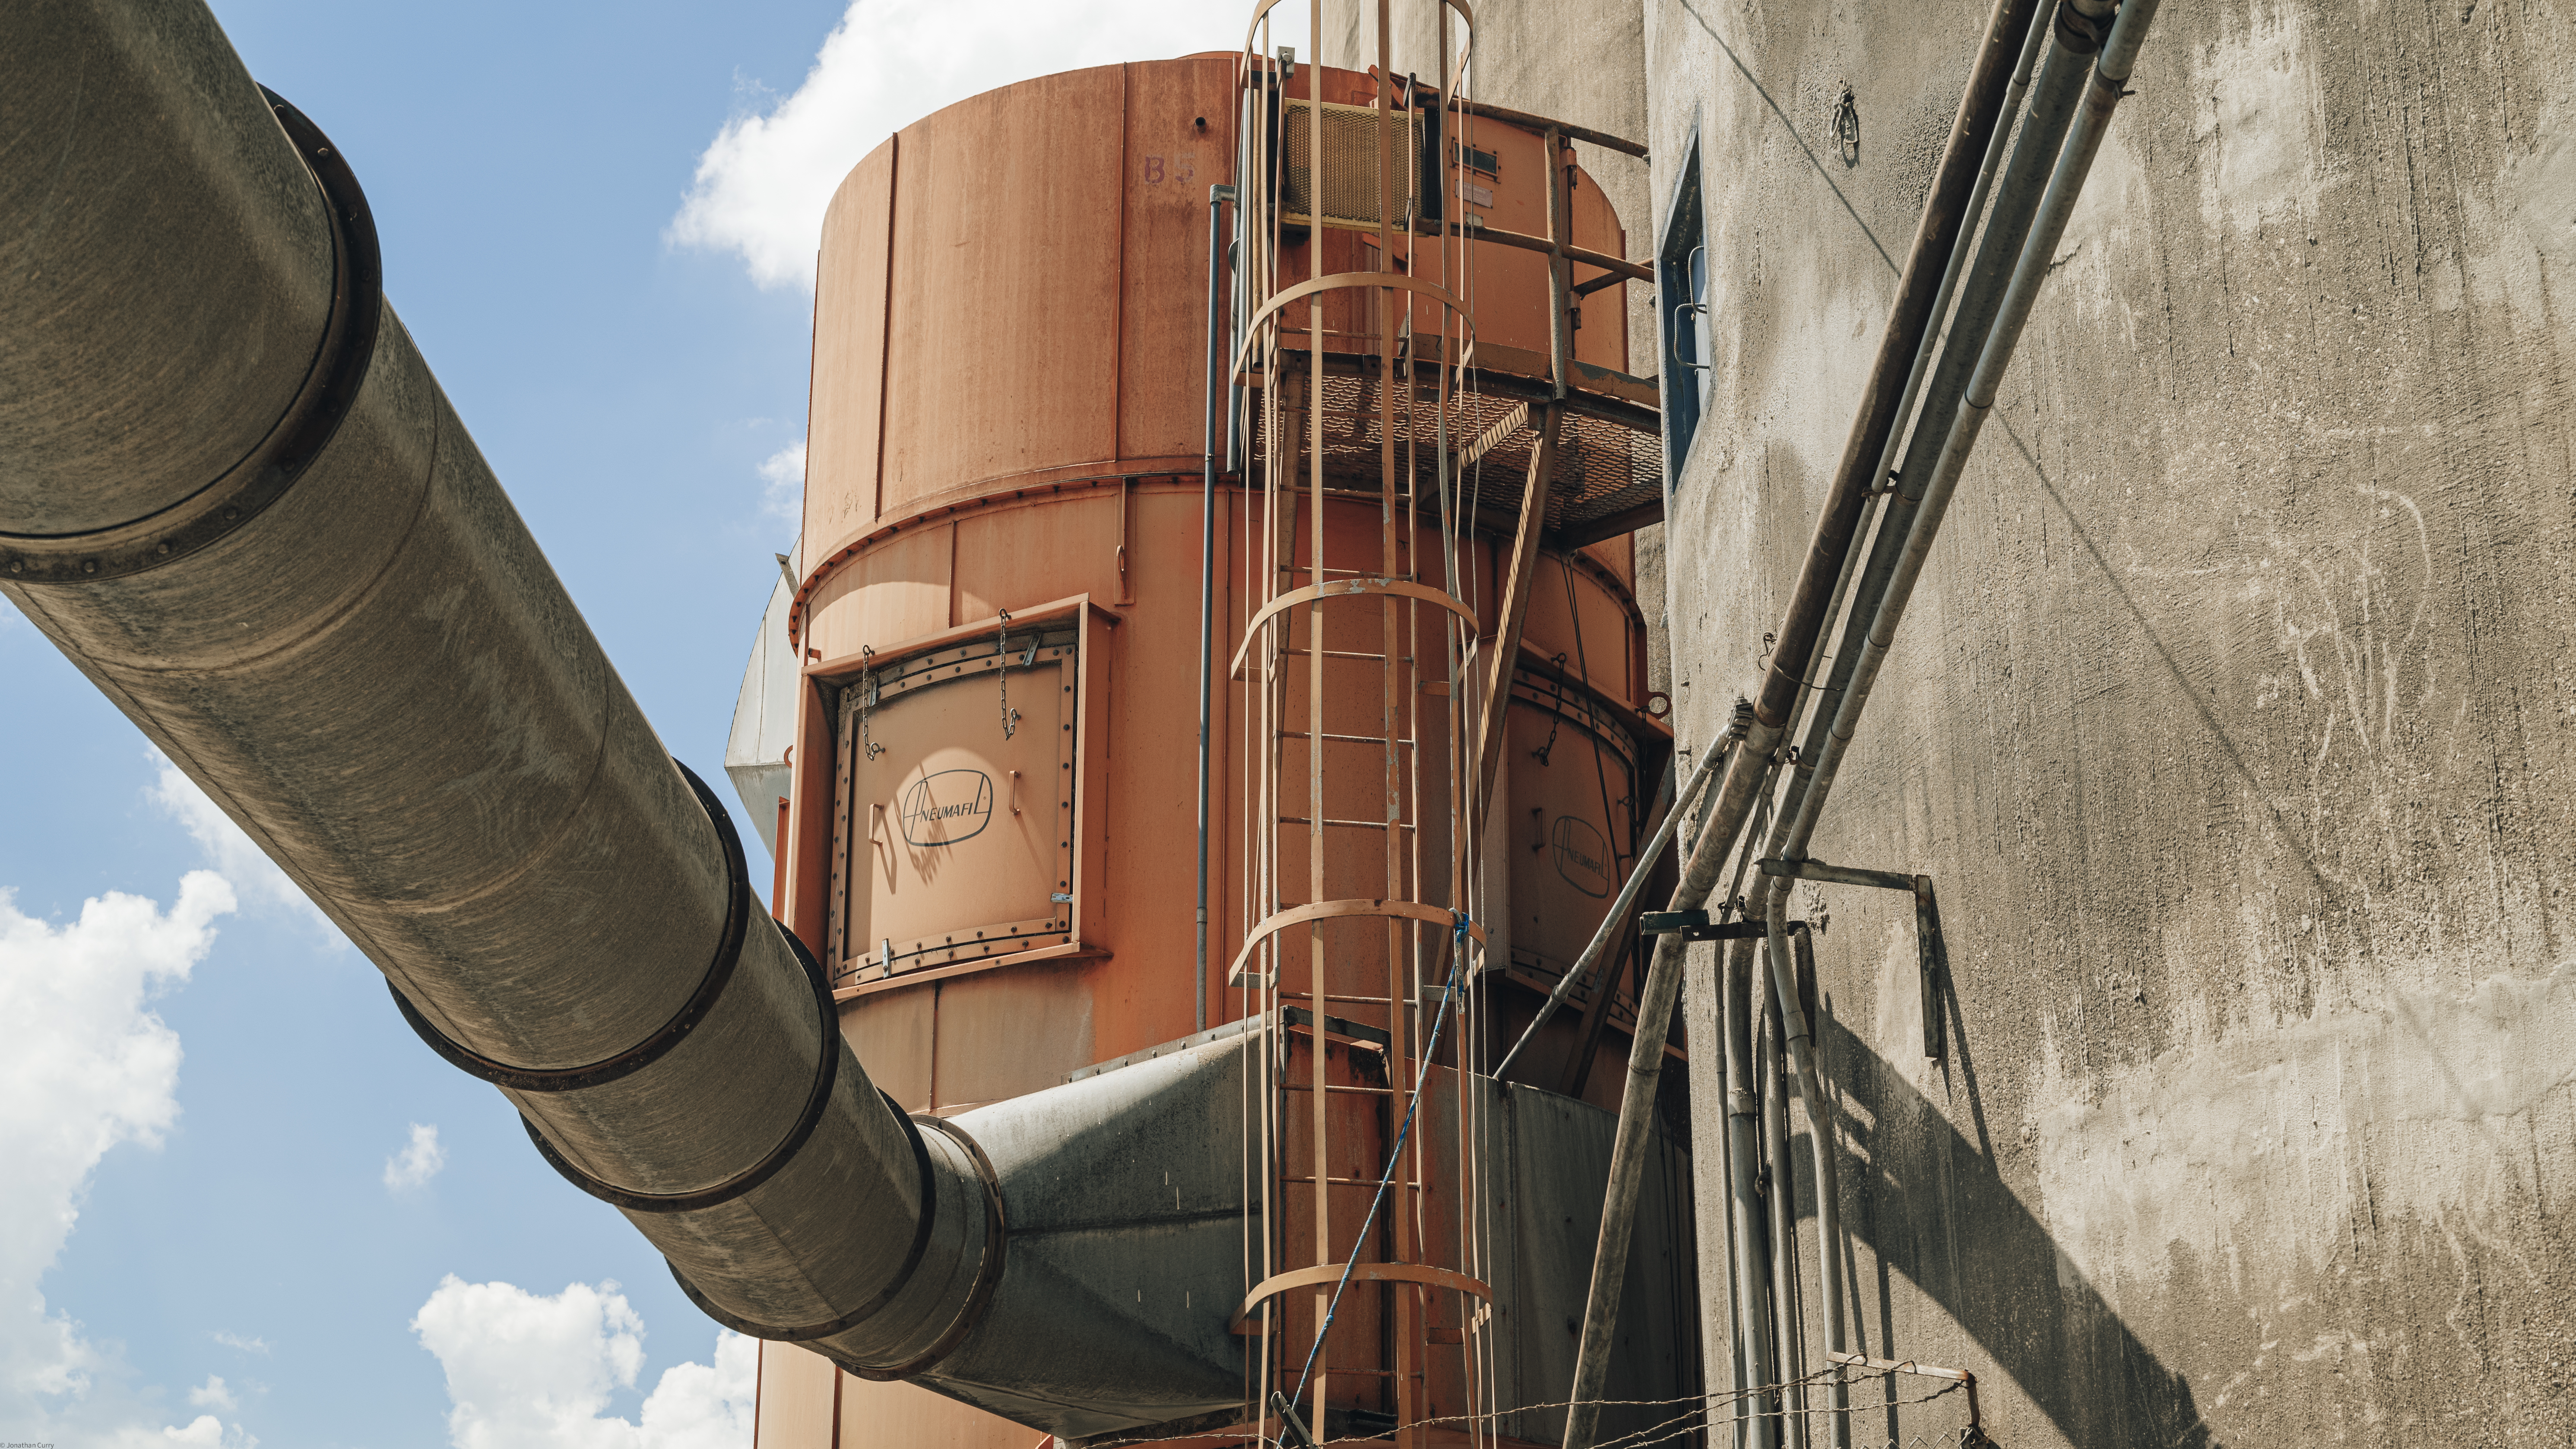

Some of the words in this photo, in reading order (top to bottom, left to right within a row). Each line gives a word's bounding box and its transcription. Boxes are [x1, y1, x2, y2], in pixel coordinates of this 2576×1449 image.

[1463, 184, 1486, 194] WANING
[904, 774, 989, 842] PNEUMAFIL
[1553, 818, 1609, 881] PNEUMAFIL
